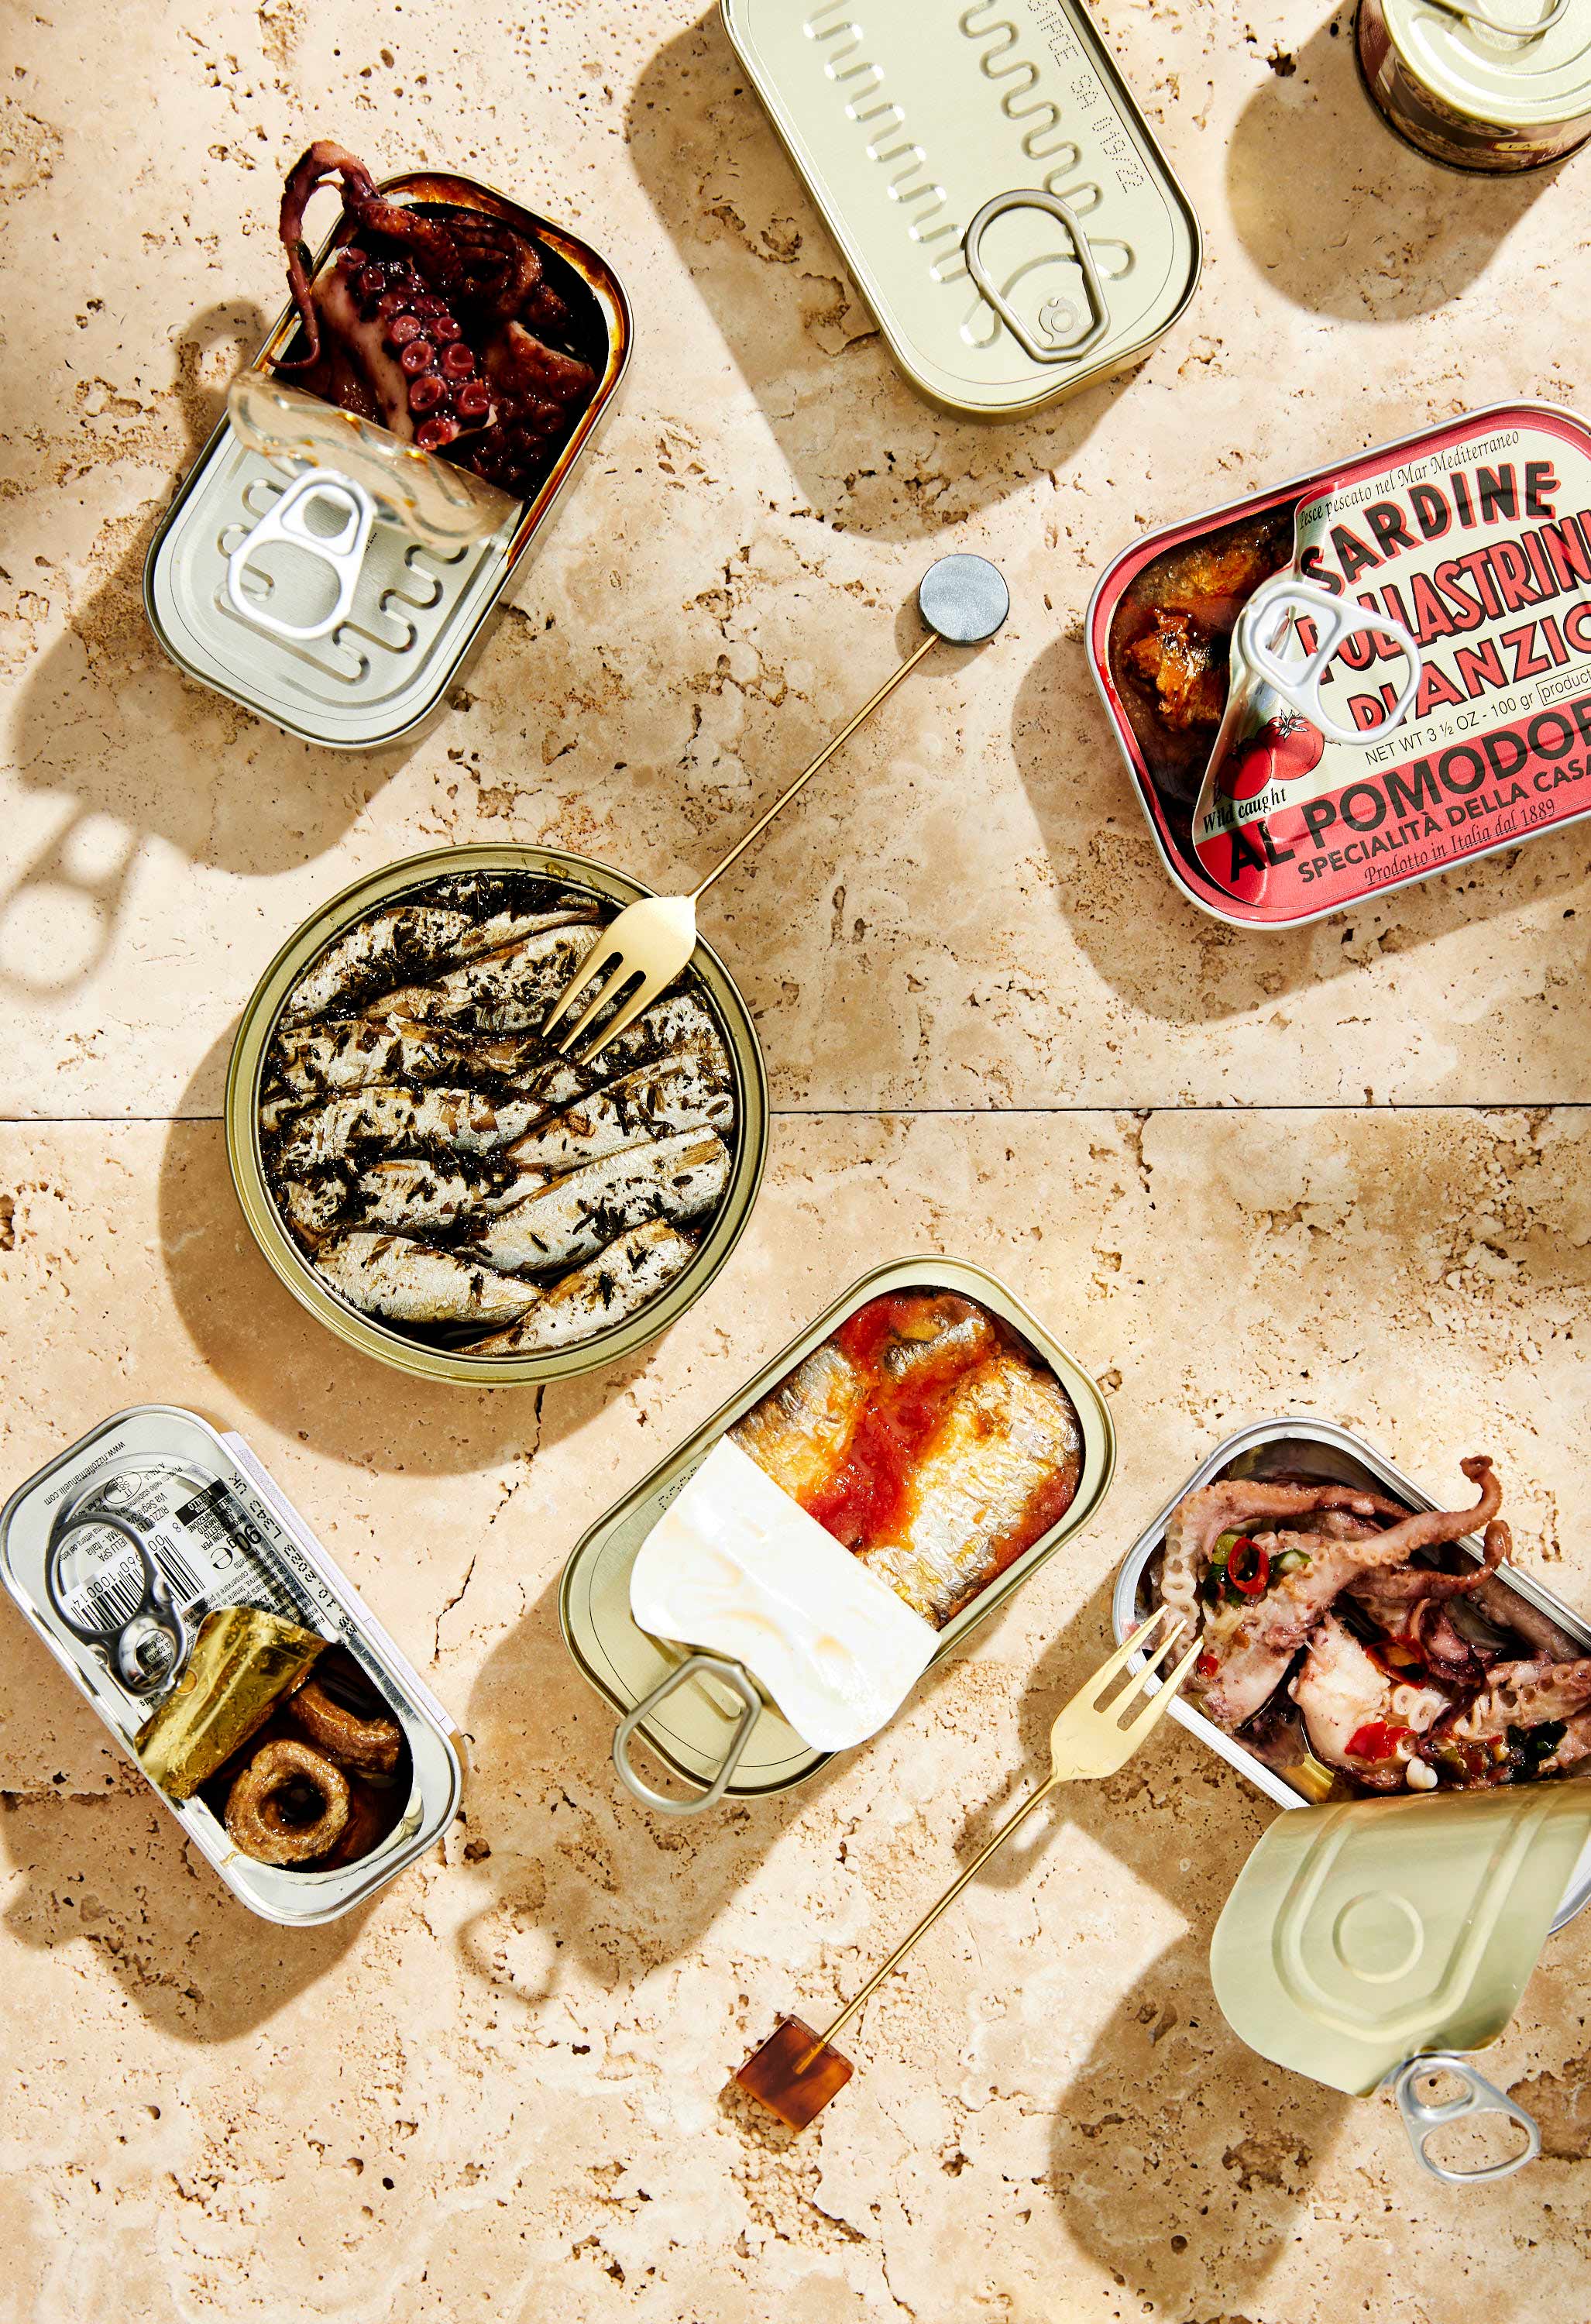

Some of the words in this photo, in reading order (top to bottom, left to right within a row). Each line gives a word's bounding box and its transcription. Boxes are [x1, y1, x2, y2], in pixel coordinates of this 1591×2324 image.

[1070, 74, 1098, 109] SA
[1325, 487, 1372, 521] pescato
[1373, 470, 1396, 495] nel
[1397, 462, 1428, 486] Mar
[1431, 430, 1519, 476] Mediterraneo
[1301, 460, 1562, 596] SARDINE
[1347, 682, 1407, 731] DI
[1365, 741, 1395, 766] NET
[1398, 732, 1424, 752] WT
[1426, 727, 1437, 742] 3
[1455, 710, 1479, 731] OZ
[1491, 696, 1517, 717] 100
[1519, 691, 1534, 710] gr
[1203, 803, 1235, 834] Wild
[1238, 787, 1286, 820] caught
[1297, 813, 1442, 883] SPECIALITÀ
[1448, 782, 1528, 827] DELLA
[1534, 753, 1591, 792] CAS
[1230, 820, 1296, 883] AL
[1363, 847, 1429, 885] Prodotto
[1428, 839, 1445, 860] in
[1449, 822, 1490, 852] Italia
[1492, 810, 1517, 836] dal
[1520, 798, 1557, 826] 1889
[44, 1442, 124, 1504] www.rizzoliemanuelli.com
[112, 1476, 123, 1487] CE
[228, 1472, 247, 1494] UK
[116, 1480, 129, 1492] 581
[123, 1489, 132, 1497] IT
[149, 1480, 162, 1491] nello
[120, 1488, 149, 1513] stabilimento
[155, 1492, 167, 1504] Via
[143, 1505, 168, 1528] RIZZOLI
[172, 1522, 180, 1532] 8
[69, 1544, 77, 1552] del
[77, 1532, 94, 1547] lettera
[86, 1541, 101, 1556] Italia
[201, 1539, 212, 1550] PER
[226, 1523, 262, 1552] 90g
[98, 1549, 112, 1562] SPA
[233, 1556, 247, 1569] netto
[72, 1572, 115, 1607] 100014
[220, 1571, 248, 1594] conservare
[228, 1586, 244, 1600] tenere
